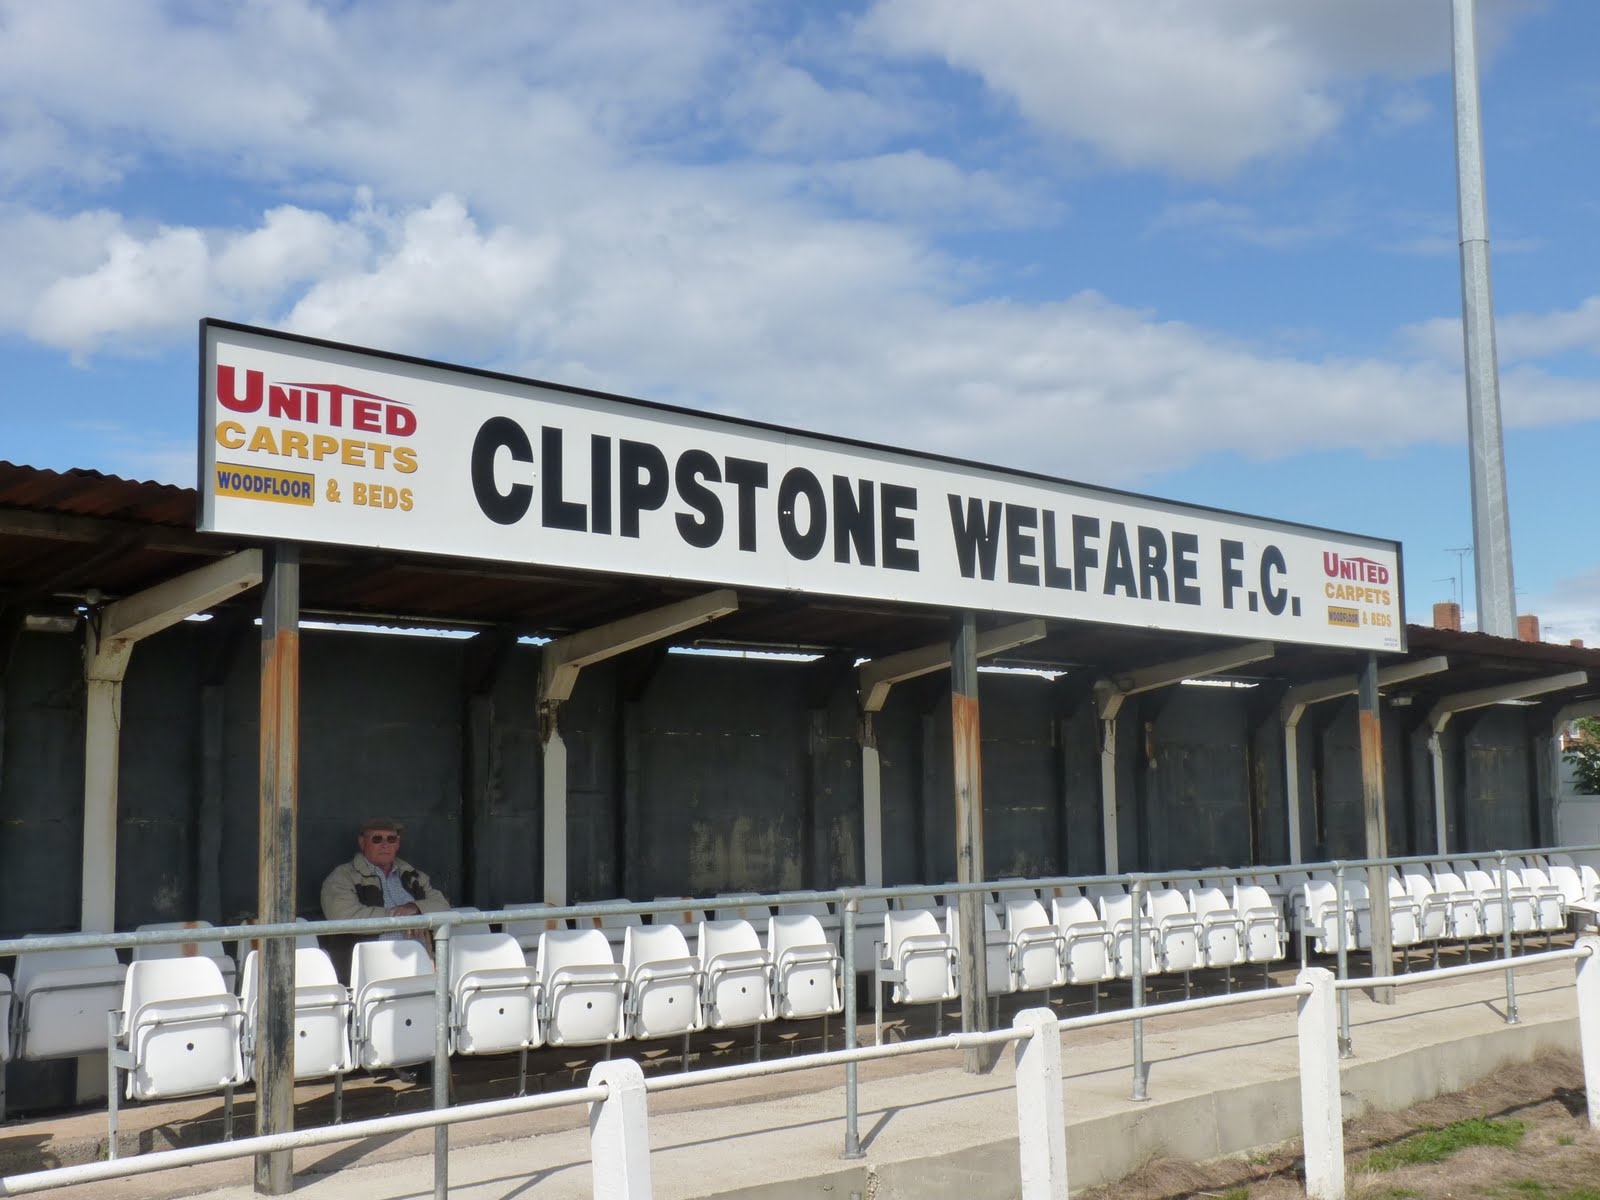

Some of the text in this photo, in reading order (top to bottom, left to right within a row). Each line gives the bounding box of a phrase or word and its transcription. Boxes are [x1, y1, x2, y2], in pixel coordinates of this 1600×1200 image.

[217, 364, 416, 436] UNITED
[215, 420, 418, 474] CARPETS
[217, 470, 414, 512] WOODFLOOR & BEDS
[471, 416, 1301, 617] CLIPSTONE WELFARE F.C.
[1323, 551, 1389, 584] UNITED
[1325, 582, 1391, 605] CARPETS
[1362, 611, 1368, 625] &
[1371, 612, 1392, 627] BEDS
